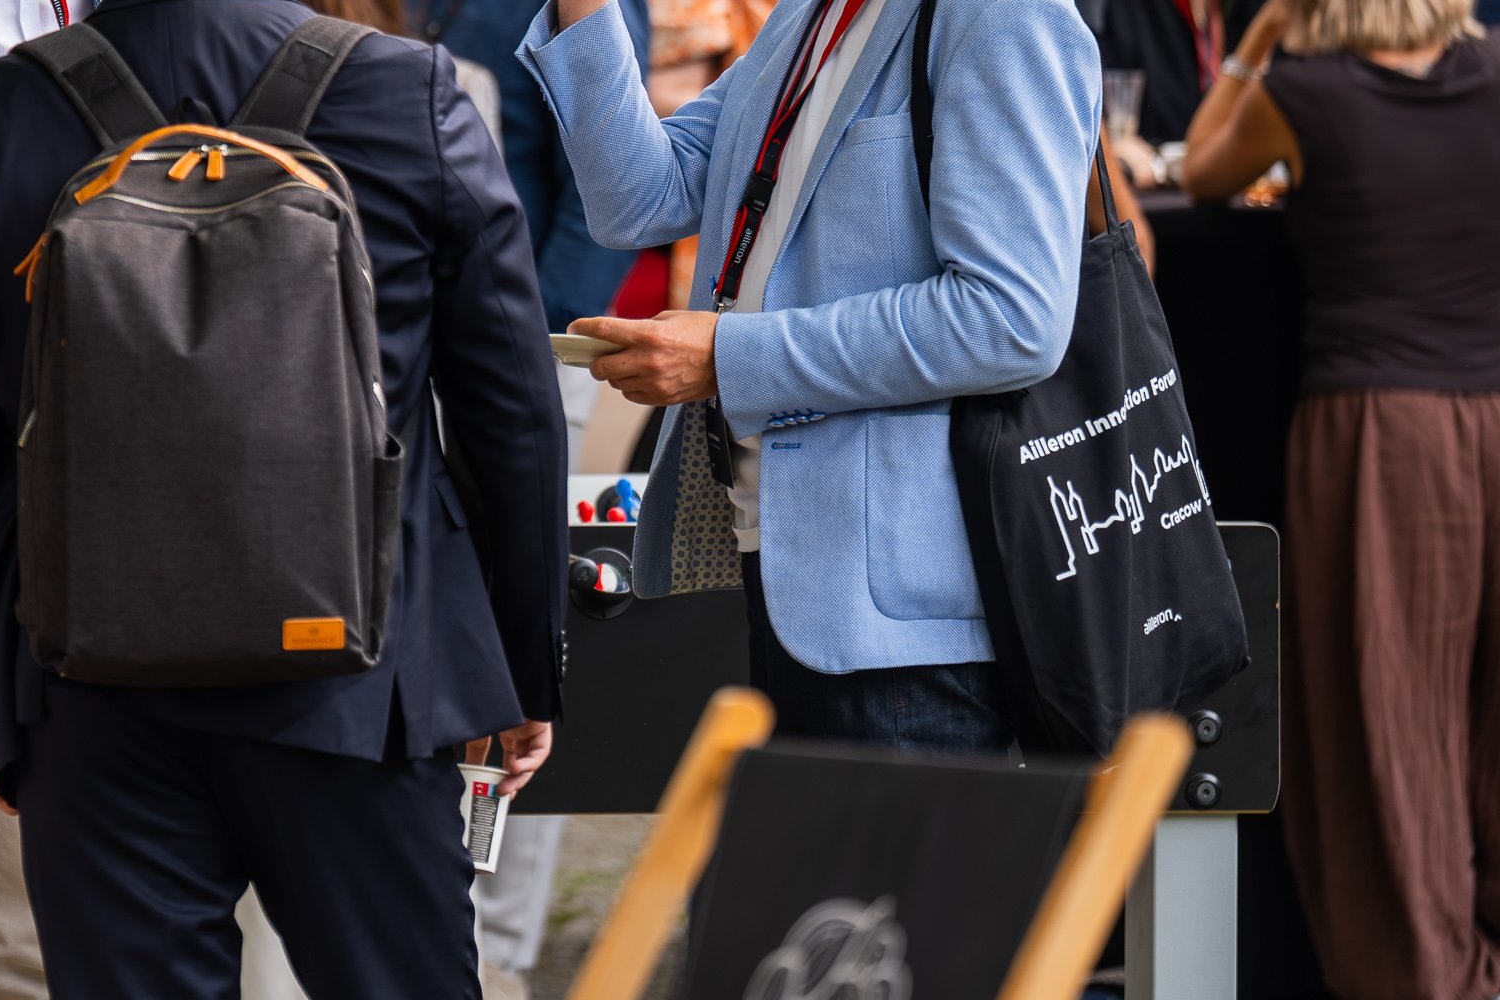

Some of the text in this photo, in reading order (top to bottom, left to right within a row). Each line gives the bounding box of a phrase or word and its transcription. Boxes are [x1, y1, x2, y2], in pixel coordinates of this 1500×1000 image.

[734, 228, 753, 264] ailleron
[1019, 426, 1086, 465] Ailleron
[1160, 498, 1202, 530] Cracow
[1143, 608, 1174, 635] ailleron
